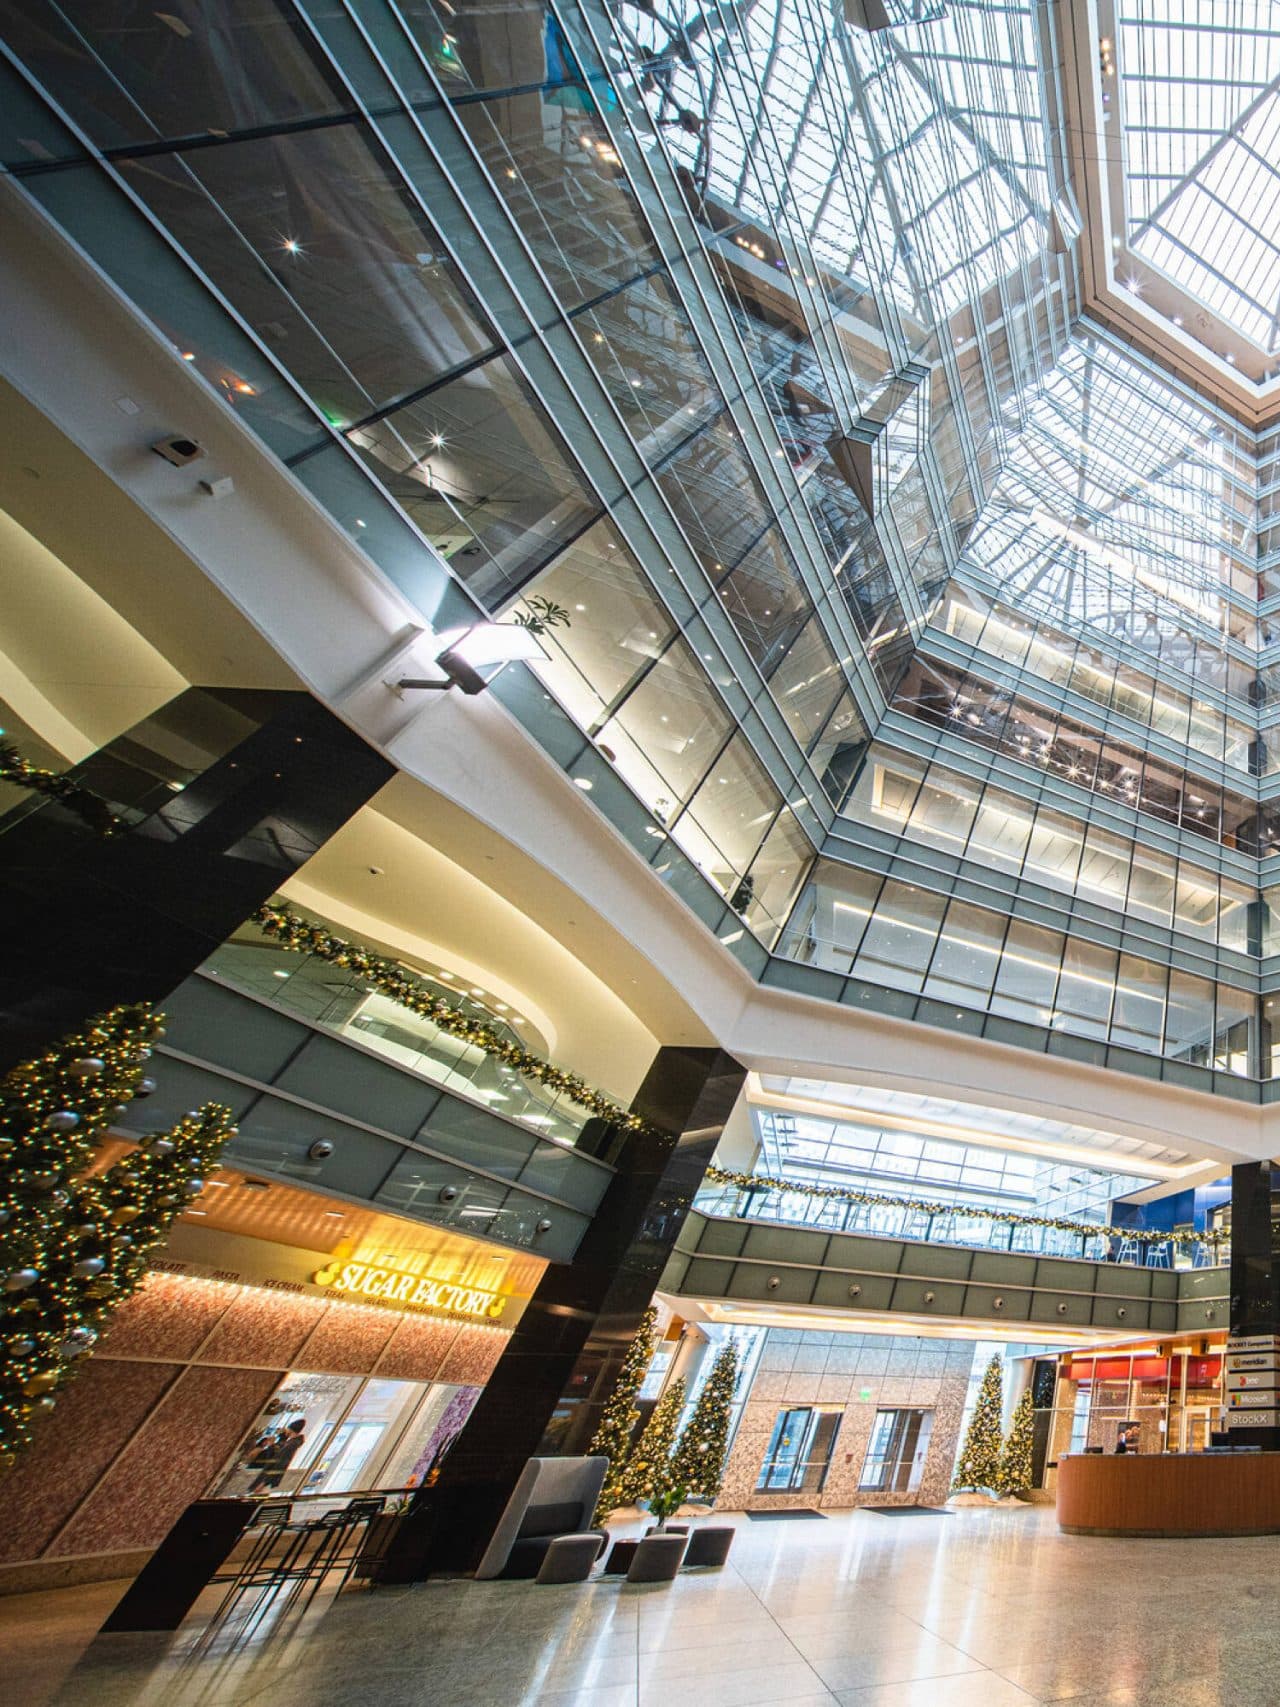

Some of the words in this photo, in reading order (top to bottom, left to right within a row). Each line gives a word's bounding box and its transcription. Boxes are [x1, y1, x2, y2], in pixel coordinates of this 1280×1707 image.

[334, 1262, 415, 1301] SUGAR
[408, 1280, 498, 1317] FACTORY
[1231, 1414, 1268, 1424] StockX
